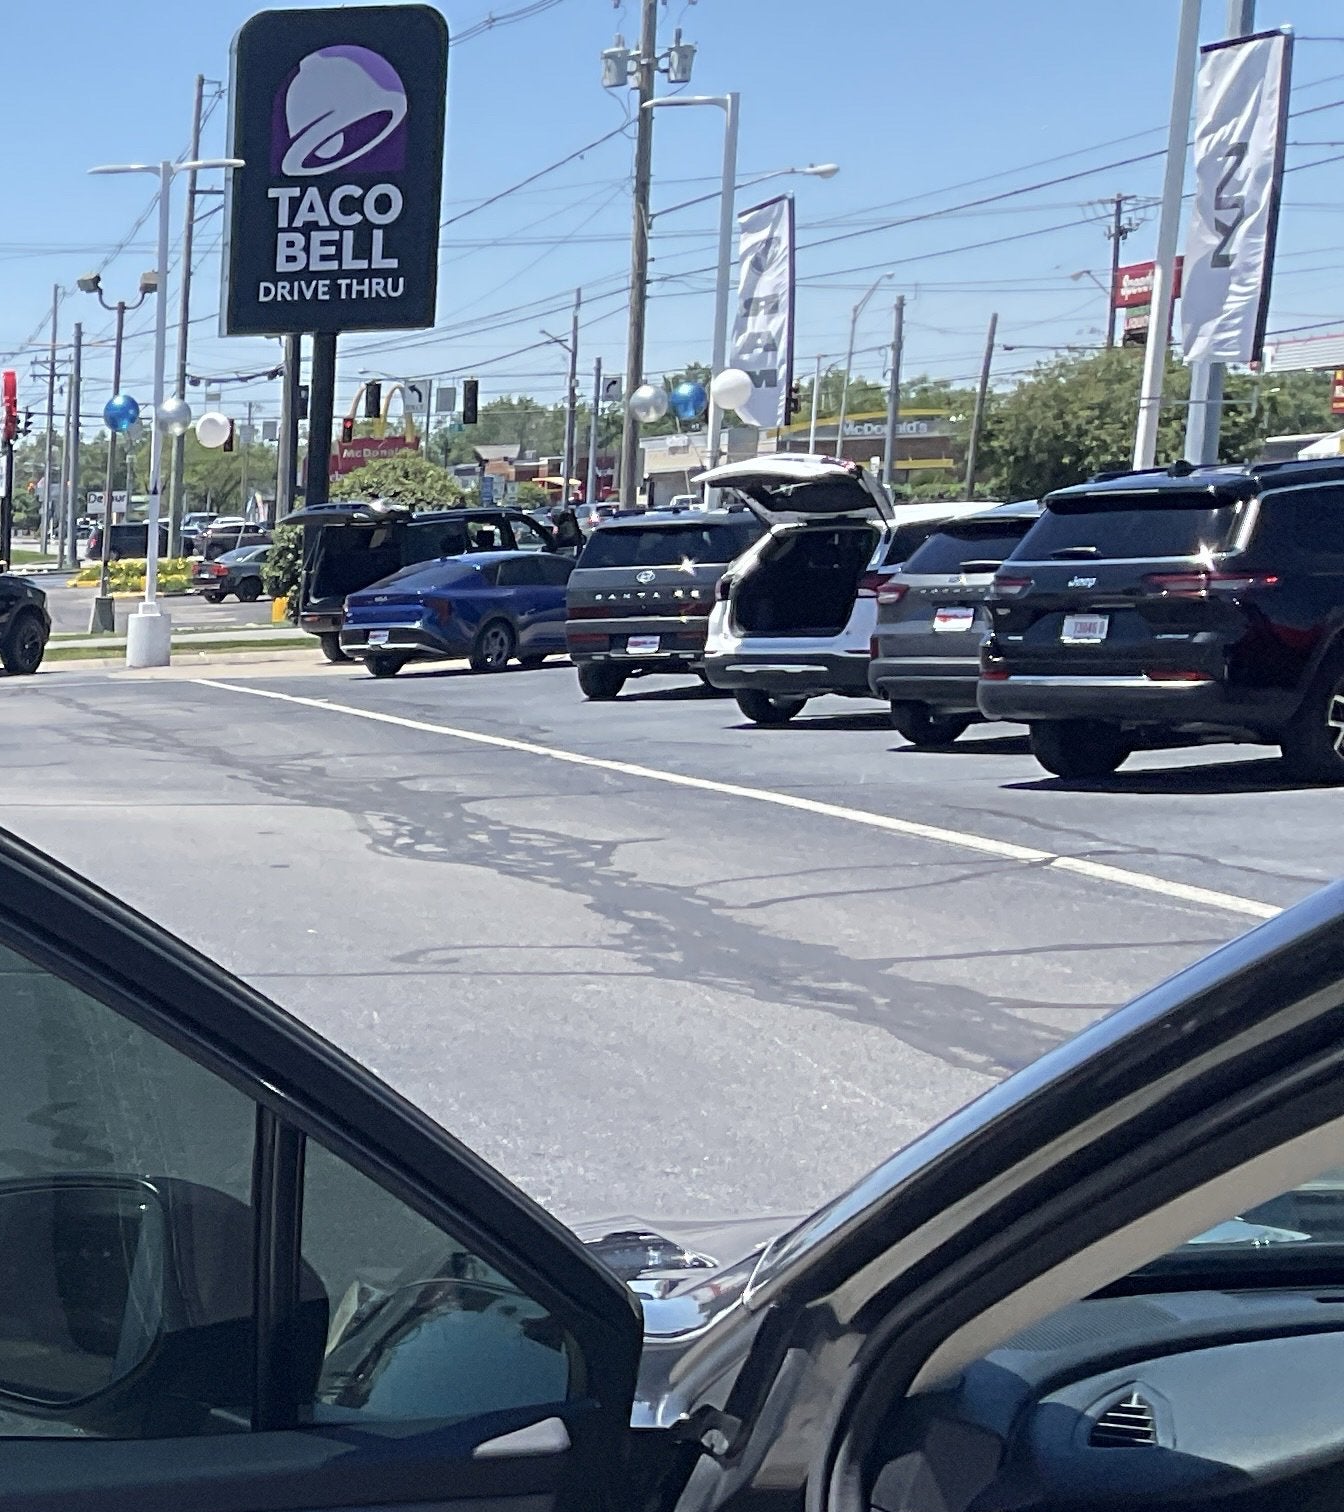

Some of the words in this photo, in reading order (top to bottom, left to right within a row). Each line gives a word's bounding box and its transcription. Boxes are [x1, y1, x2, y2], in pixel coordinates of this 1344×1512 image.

[267, 183, 403, 228] TACO
[275, 229, 399, 273] BELL
[258, 279, 330, 303] DRIVE
[337, 277, 405, 300] THRU
[843, 421, 928, 435] McDoald's
